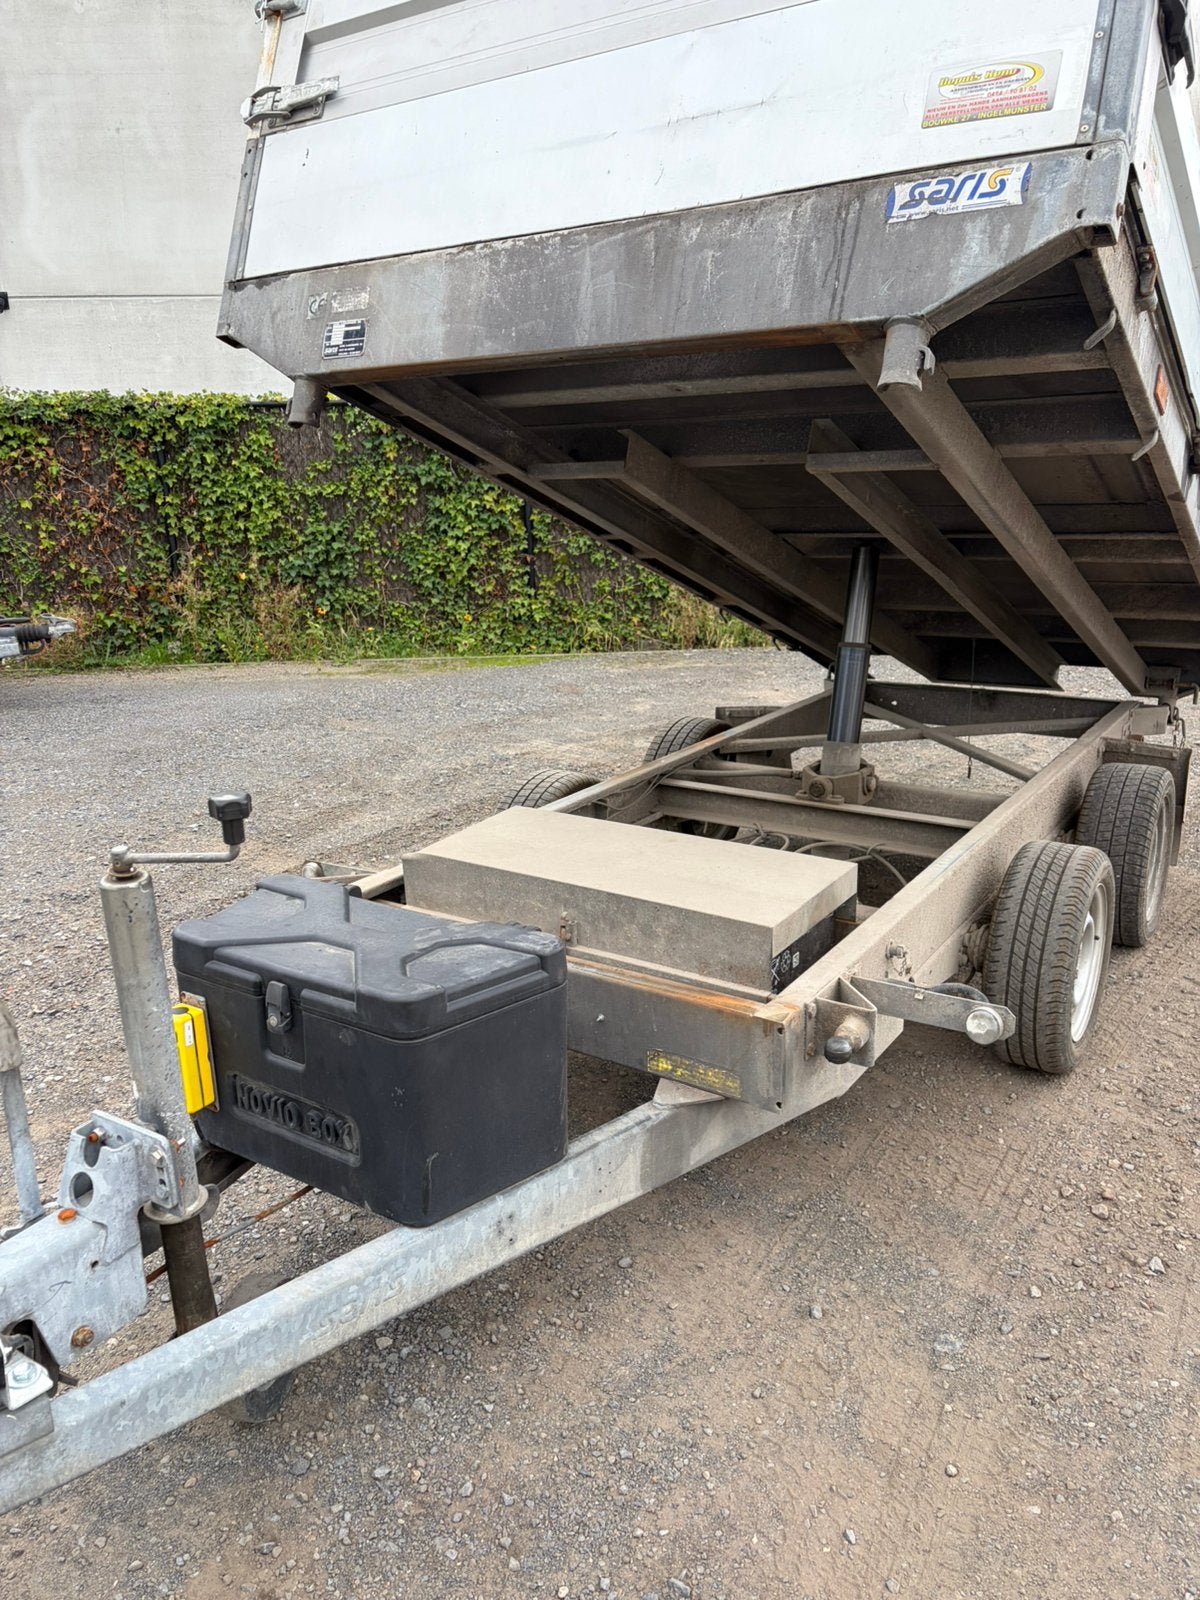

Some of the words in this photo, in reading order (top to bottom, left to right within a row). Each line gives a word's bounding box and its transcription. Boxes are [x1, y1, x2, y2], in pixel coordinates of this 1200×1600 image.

[991, 91, 1048, 103] AANHANGWAGENS
[922, 117, 959, 128] BOUWKE
[977, 102, 1047, 119] INGELMUNSTER
[898, 168, 1015, 211] saris
[237, 1080, 301, 1130] NOVIO
[305, 1108, 358, 1153] BOX
